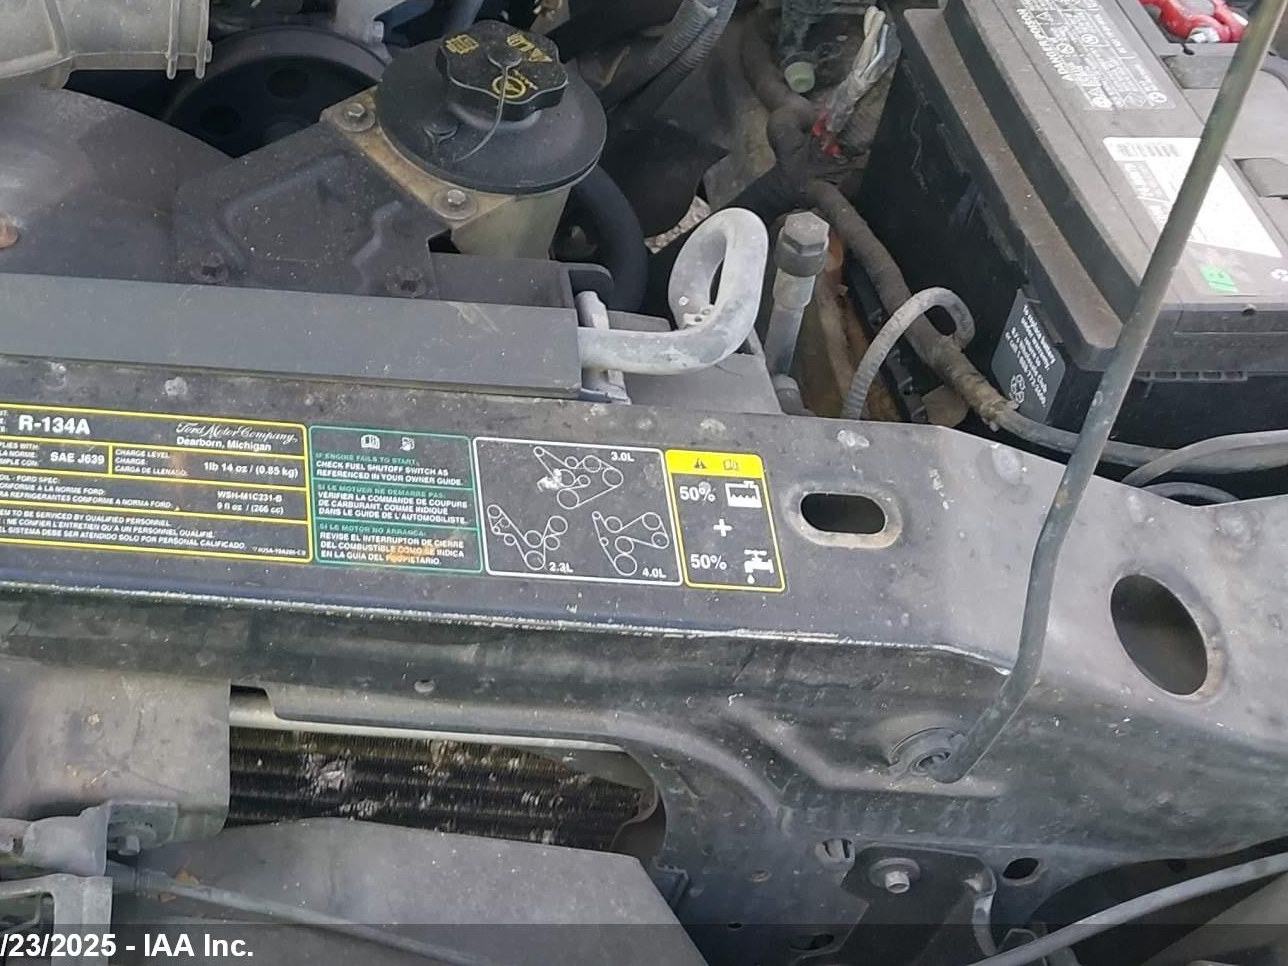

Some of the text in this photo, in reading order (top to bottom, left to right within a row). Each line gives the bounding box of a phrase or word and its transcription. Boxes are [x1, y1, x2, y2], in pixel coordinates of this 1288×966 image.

[18, 414, 90, 435] R-134A
[176, 421, 206, 435] Ford
[176, 436, 271, 452] Dearborn, Michigan
[49, 451, 105, 464] SAE J639
[611, 451, 634, 462] 3.0L
[220, 462, 234, 473] 14
[235, 463, 248, 474] oz
[255, 465, 279, 476] (0.85
[280, 466, 298, 477] kg)
[437, 468, 448, 476] AS
[679, 485, 716, 502] 50%
[216, 502, 222, 510] 9
[231, 503, 241, 511] oz
[549, 562, 573, 573] 2.3L
[690, 554, 727, 571] 50%
[643, 567, 666, 579] 4.0L
